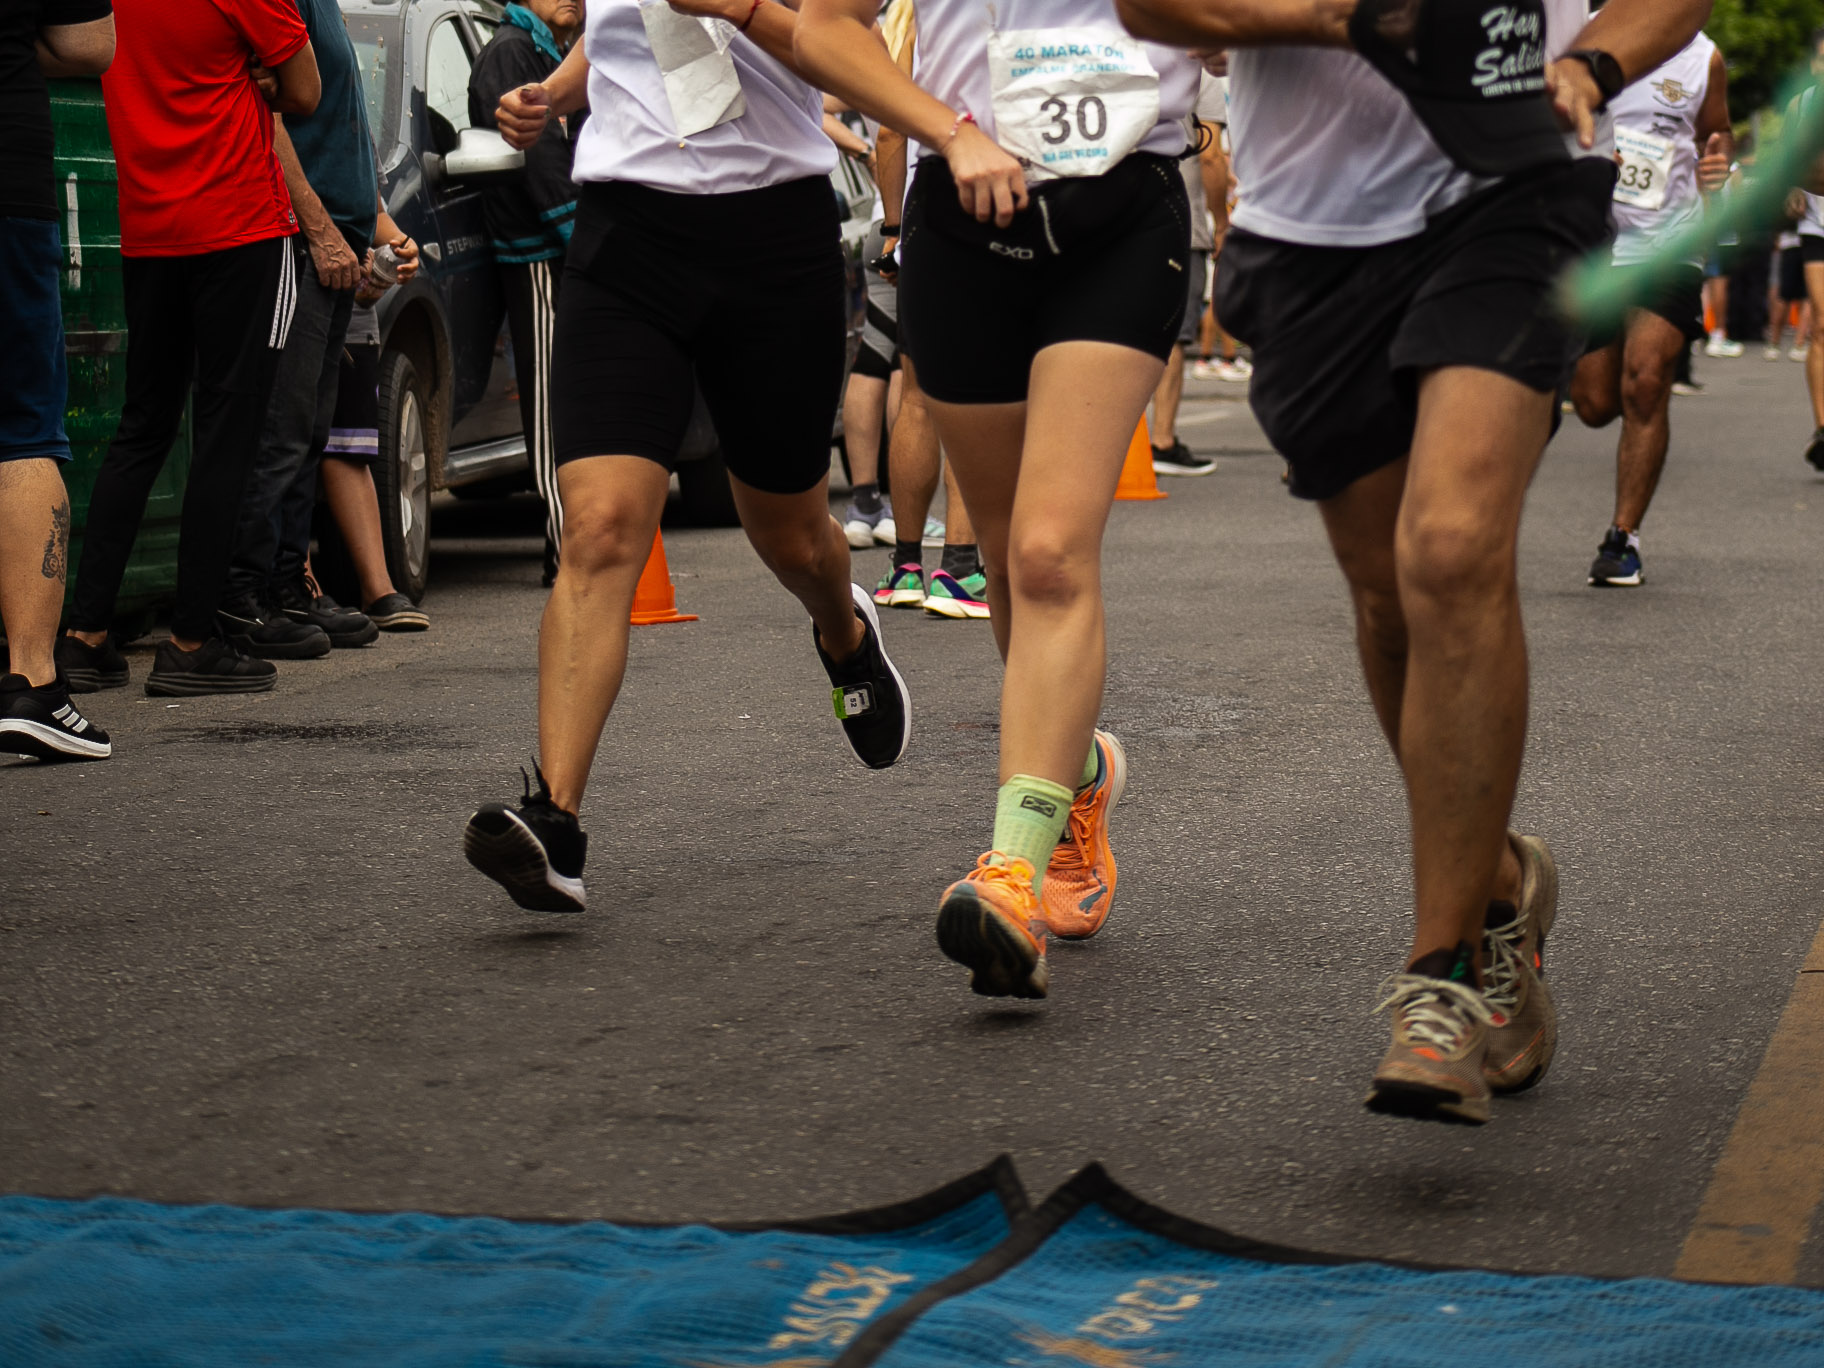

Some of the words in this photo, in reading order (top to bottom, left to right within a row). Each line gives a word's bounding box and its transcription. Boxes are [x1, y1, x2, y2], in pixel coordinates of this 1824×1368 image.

[1481, 6, 1539, 44] Hay
[1014, 47, 1035, 60] 40
[1471, 41, 1545, 86] Salid
[1040, 96, 1107, 145] 30
